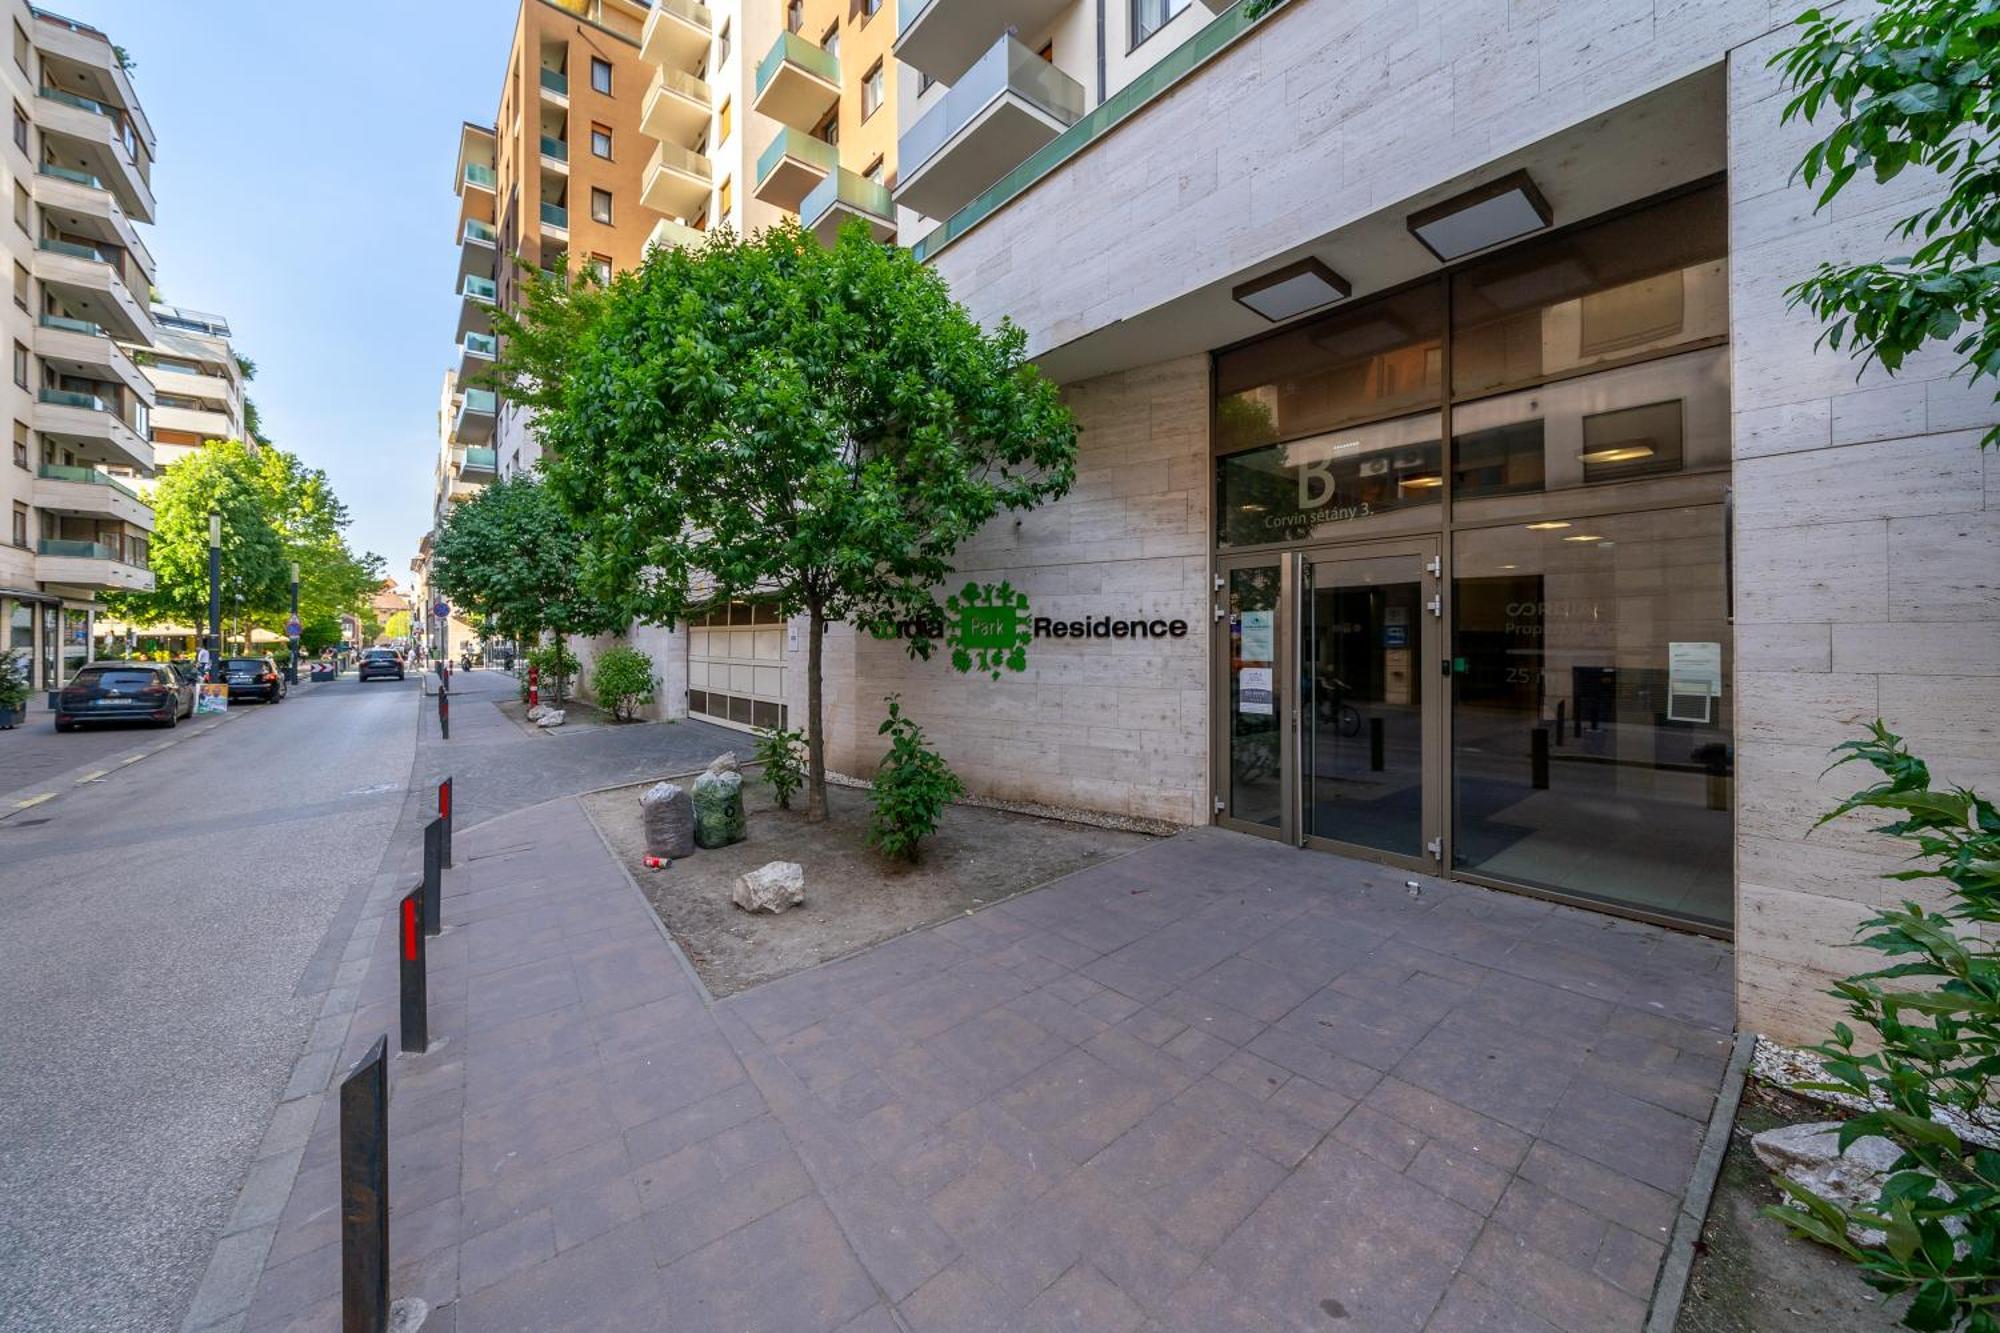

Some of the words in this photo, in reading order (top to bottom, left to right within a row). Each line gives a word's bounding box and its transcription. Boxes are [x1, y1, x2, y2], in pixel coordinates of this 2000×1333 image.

[1298, 441, 1336, 509] B
[1264, 511, 1307, 529] Corvin
[1360, 502, 1374, 517] 3.
[971, 616, 1004, 637] Park
[1033, 615, 1189, 639] Residence
